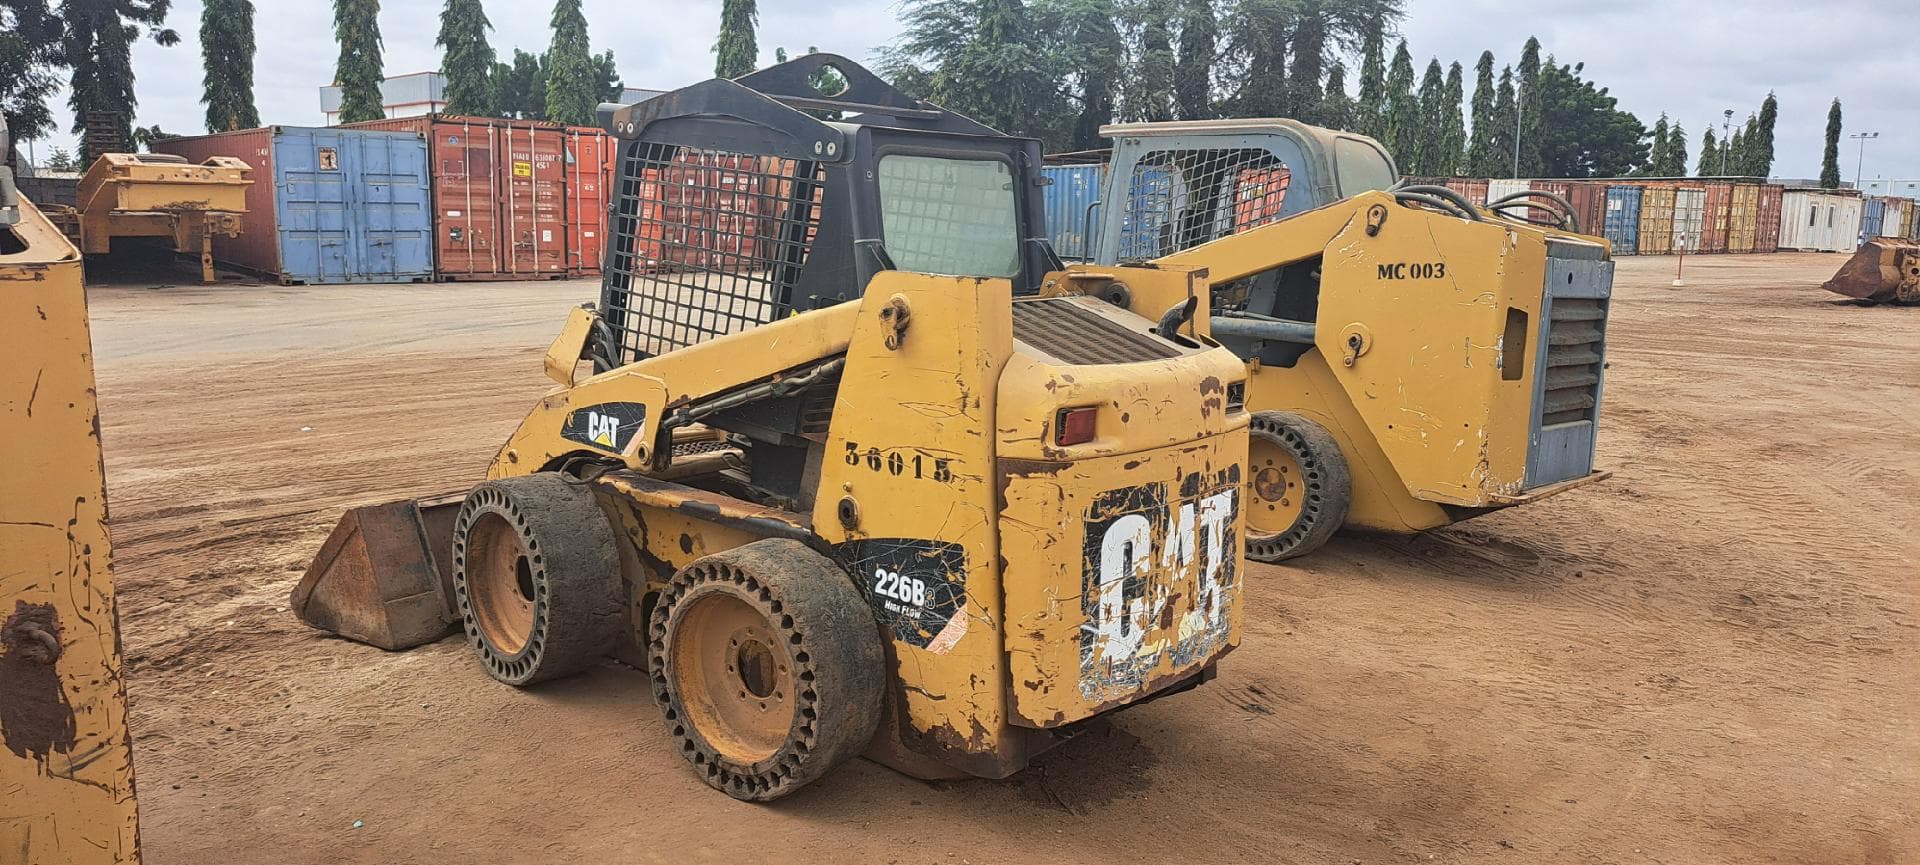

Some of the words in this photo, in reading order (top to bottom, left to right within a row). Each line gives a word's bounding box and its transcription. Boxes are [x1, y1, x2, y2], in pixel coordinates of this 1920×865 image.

[1377, 263, 1406, 280] MC
[1410, 262, 1445, 279] 003
[588, 411, 620, 448] CAT
[1099, 488, 1233, 660] CAT
